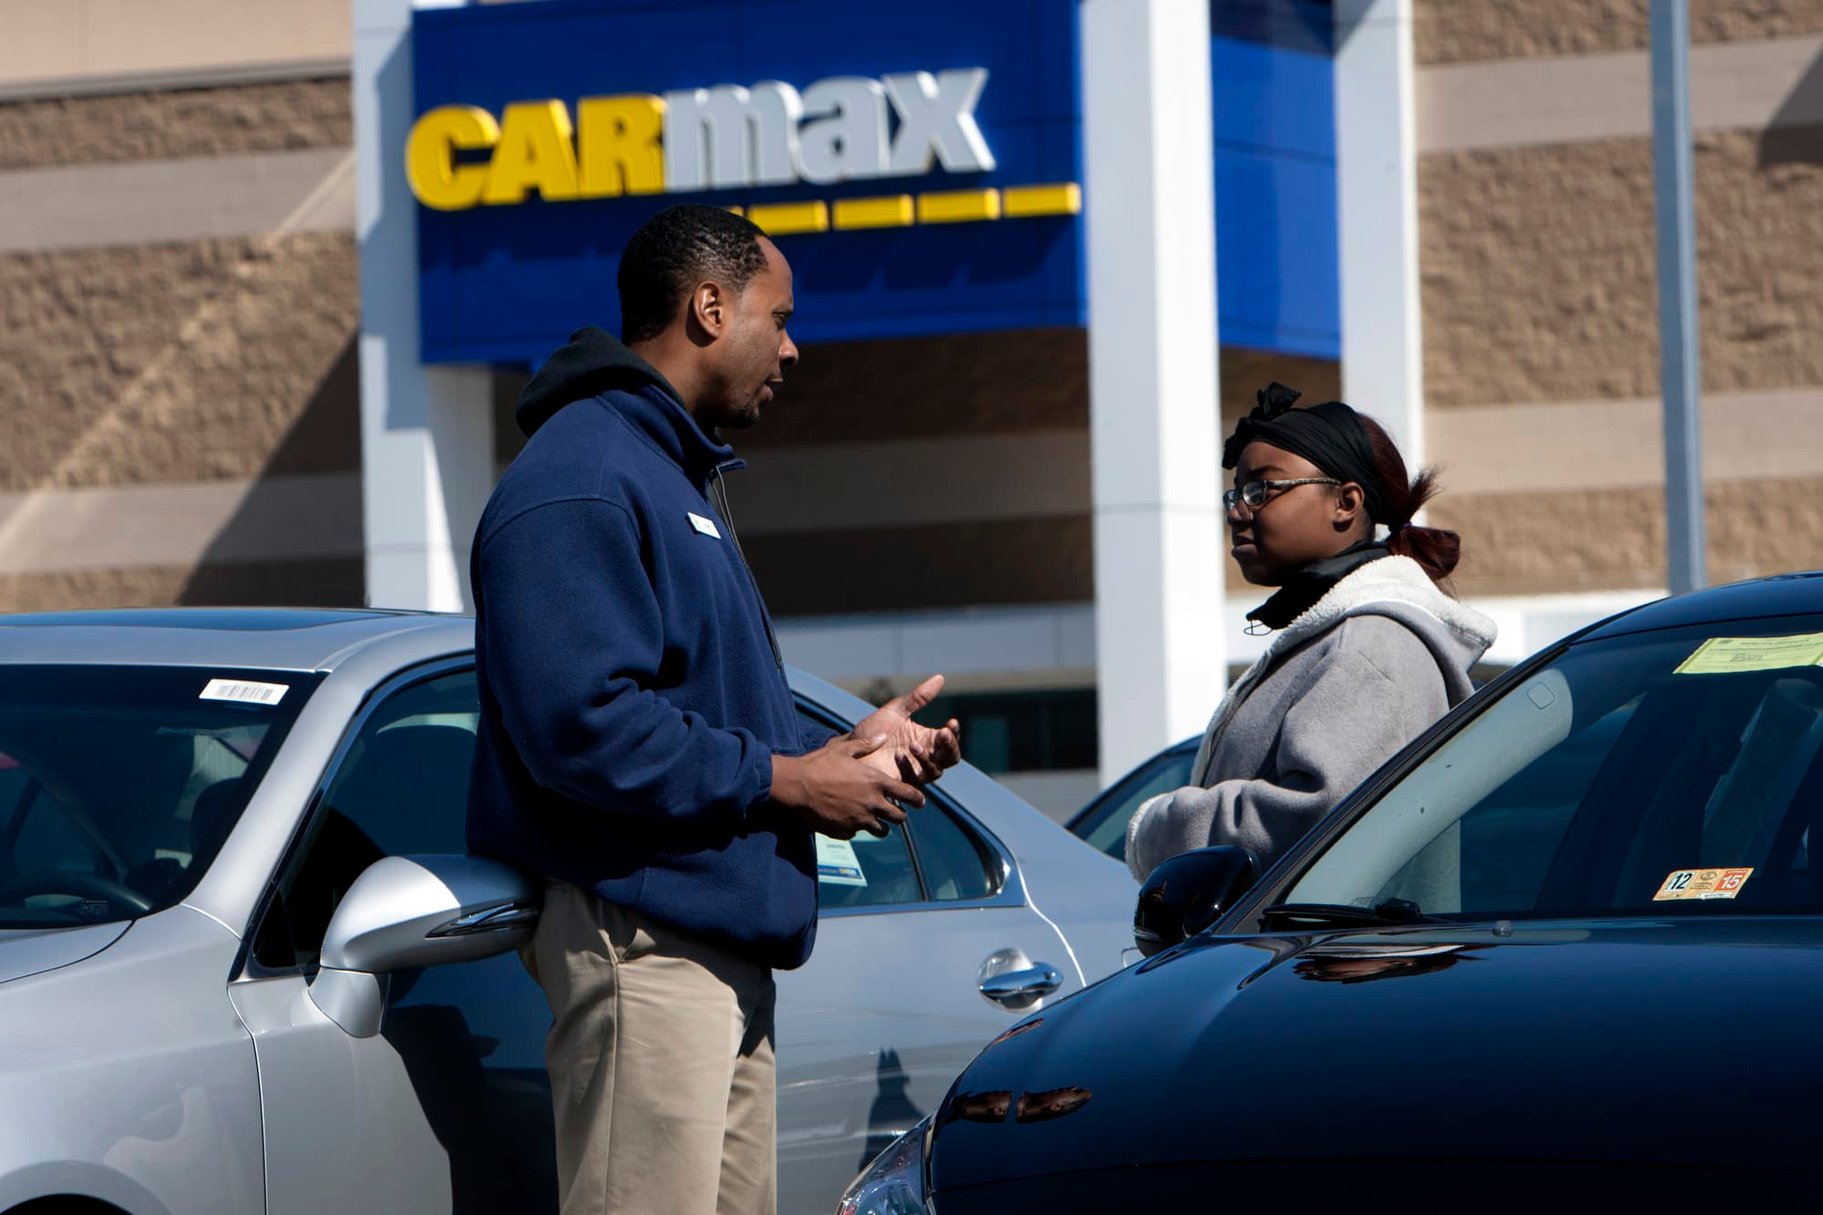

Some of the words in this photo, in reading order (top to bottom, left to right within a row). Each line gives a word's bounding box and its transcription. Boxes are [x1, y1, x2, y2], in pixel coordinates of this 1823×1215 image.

[405, 68, 995, 210] CARmax
[1671, 873, 1693, 890] 12
[1720, 875, 1743, 889] 15
